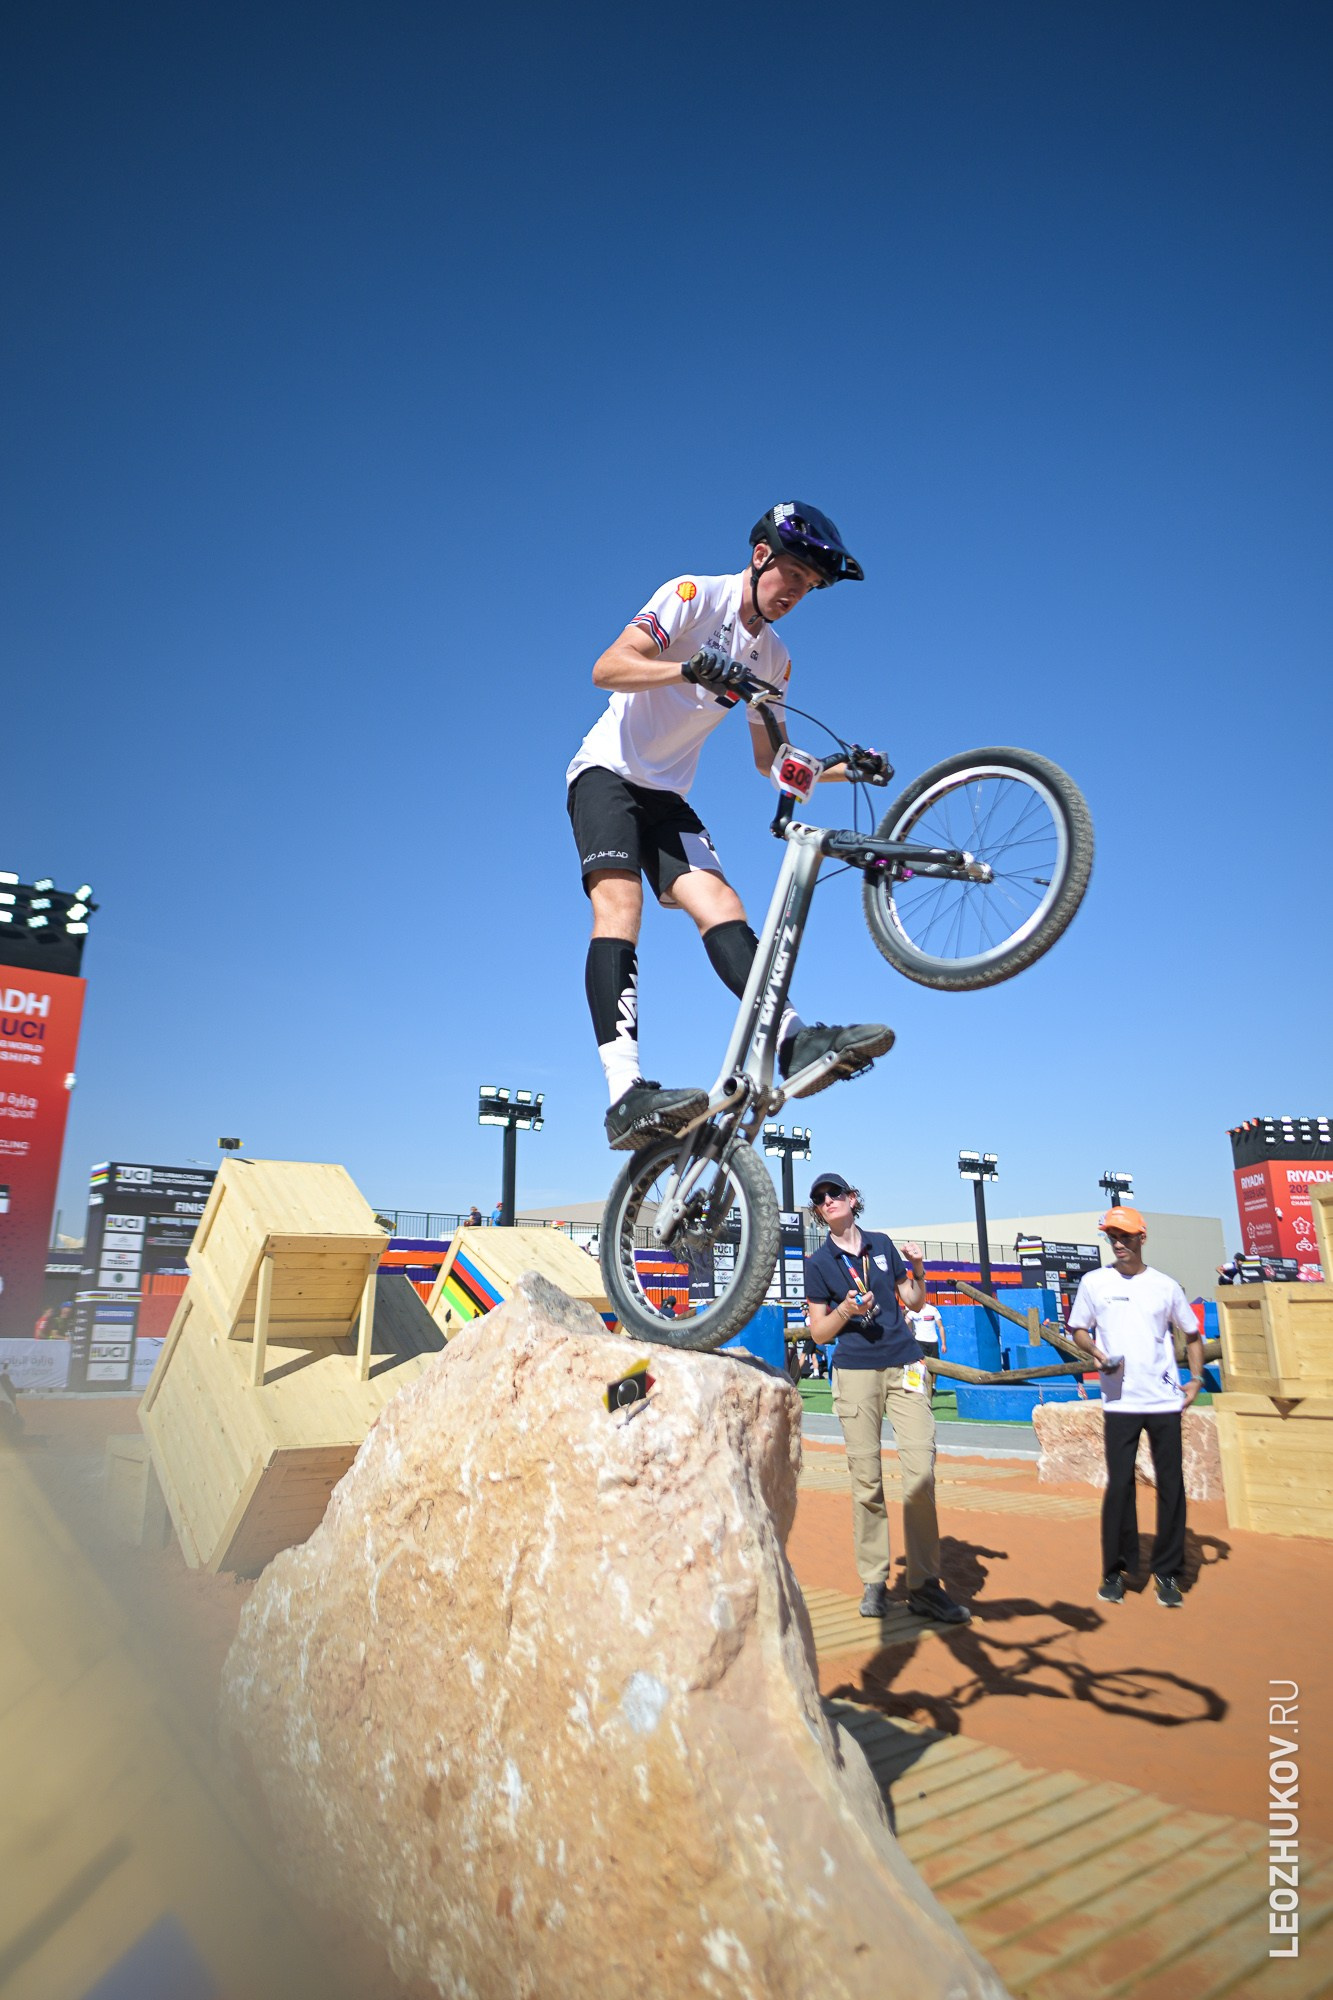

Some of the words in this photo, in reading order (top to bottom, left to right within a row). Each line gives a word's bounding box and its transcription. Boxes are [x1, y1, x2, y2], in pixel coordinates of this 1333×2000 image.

[597, 850, 629, 859] AHEAD
[2, 1018, 46, 1040] UCI
[123, 1169, 148, 1181] UCI
[1241, 1173, 1265, 1190] RIYADH
[115, 1218, 140, 1229] UCI
[718, 1246, 732, 1254] UCI
[99, 1346, 126, 1358] UCI
